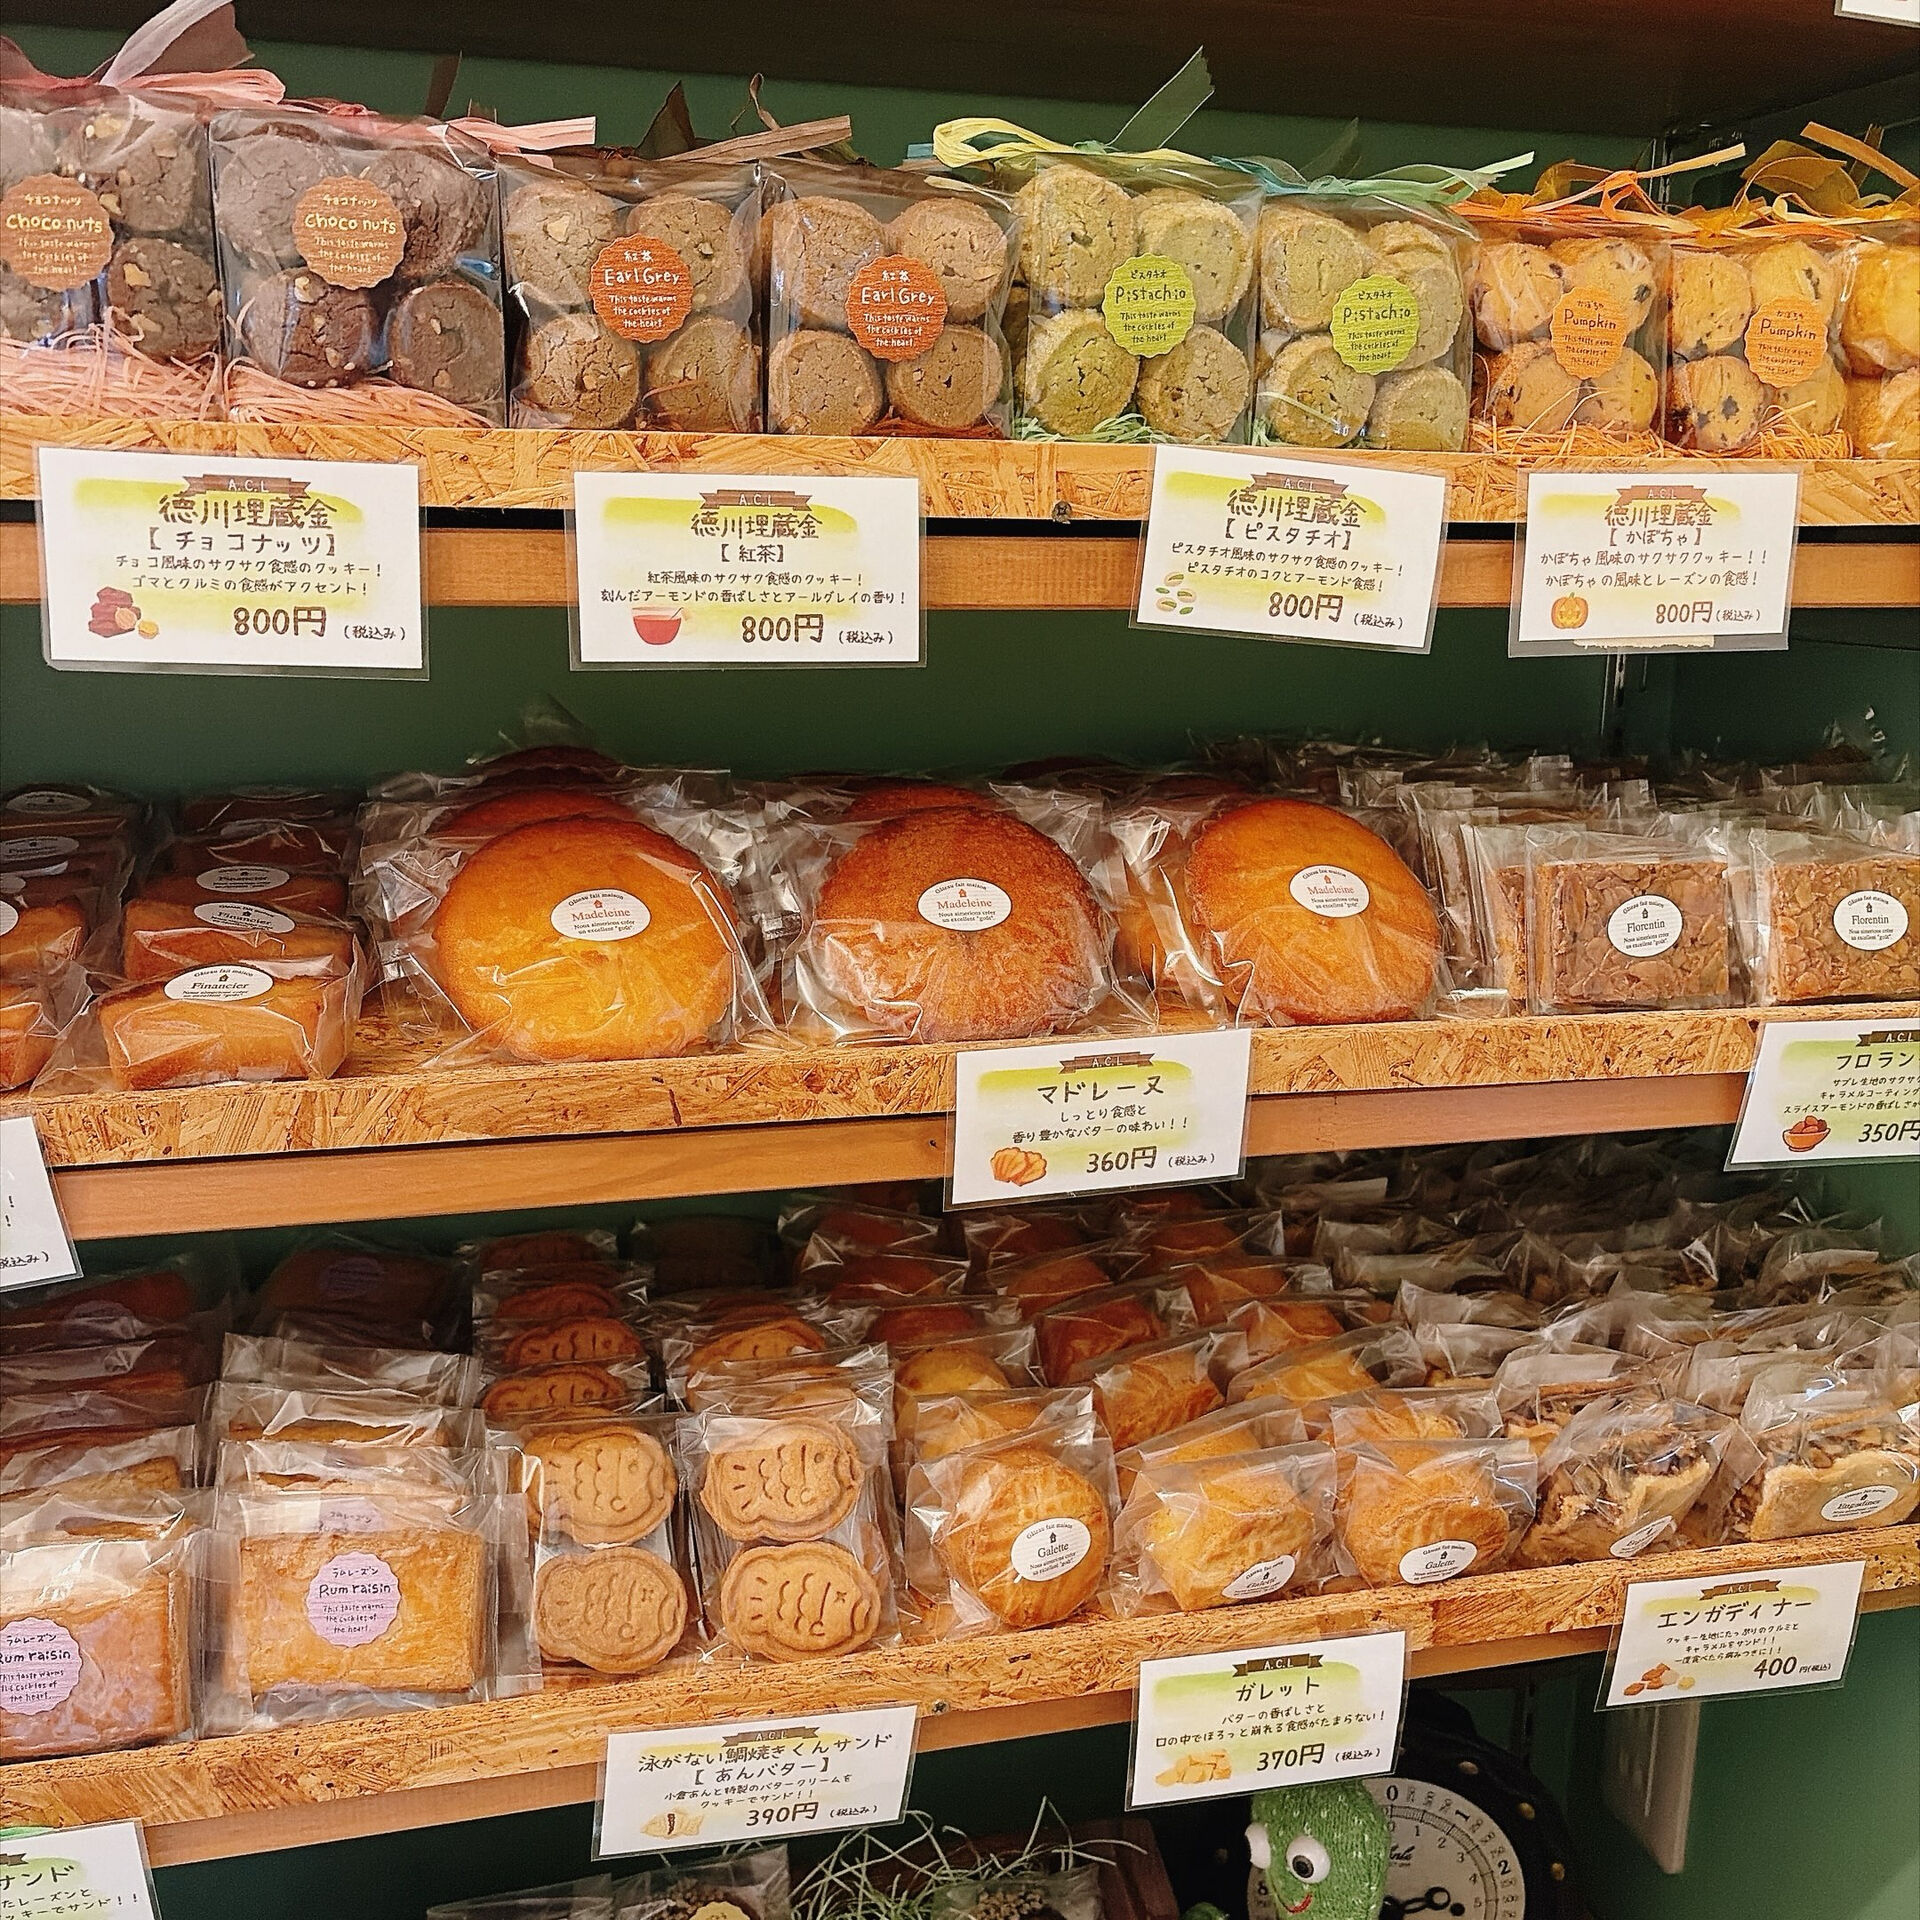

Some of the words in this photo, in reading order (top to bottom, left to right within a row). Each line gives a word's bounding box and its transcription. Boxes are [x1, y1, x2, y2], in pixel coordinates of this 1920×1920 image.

[6, 213, 61, 230] Choco
[66, 216, 103, 233] nuts
[304, 213, 358, 231] Choco
[362, 218, 396, 235] nuts
[624, 250, 654, 262] 紅茶
[604, 267, 639, 286] Earl
[643, 267, 680, 285] Grey
[881, 270, 911, 282] 紅茶
[608, 295, 627, 304] This
[629, 295, 651, 304] taste
[861, 286, 895, 305] Earl
[898, 287, 935, 306] Grey
[1115, 283, 1187, 304] Pistachio
[613, 306, 627, 315] the
[863, 313, 882, 322] This
[883, 314, 903, 323] taste
[1343, 303, 1411, 324] Pistachio
[623, 318, 637, 328] the
[1564, 308, 1617, 331] Pumpkin
[866, 325, 880, 334] the
[1760, 317, 1817, 341] Pumpkin
[875, 338, 889, 347] the
[227, 478, 271, 494] A.C.L
[738, 493, 777, 507] A.C.L
[157, 494, 339, 530] 徳川埋蔵金
[1227, 488, 1367, 529] 徳川埋蔵金
[1604, 503, 1718, 528] 徳川埋蔵金
[690, 511, 824, 540] 徳川埋蔵金
[1267, 592, 1344, 623] 800円
[1655, 601, 1713, 625] 800円
[233, 605, 327, 638] 800円
[741, 613, 824, 643] 800円
[1307, 885, 1355, 895] Madeleine
[937, 899, 992, 910] Madeleine
[571, 909, 631, 921] Madeleine
[1852, 915, 1889, 925] Florentin
[1627, 919, 1665, 933] Florentin
[191, 982, 250, 990] Financier
[1885, 1032, 1914, 1043] A.C.L
[1092, 1055, 1123, 1068] A.C.L
[1836, 1051, 1920, 1071] フロラン
[1060, 1104, 1147, 1124] しっとり食感と
[1858, 1119, 1920, 1143] 350円
[1086, 1145, 1158, 1174] 360円
[1038, 1543, 1069, 1558] Galette
[332, 1566, 379, 1578] ラムレーズン
[1425, 1560, 1455, 1569] Galette
[319, 1584, 349, 1598] Rum
[352, 1583, 391, 1595] raisin
[323, 1604, 340, 1613] This
[341, 1604, 360, 1613] taste
[1657, 1598, 1812, 1629] エンガディナー
[326, 1615, 338, 1623] the
[334, 1626, 346, 1634] the
[7, 1633, 57, 1646] ラムレーズン
[29, 1650, 71, 1661] raisin
[1262, 1658, 1294, 1670] A.C.L
[1754, 1656, 1797, 1679] 400
[0, 1673, 14, 1682] This
[17, 1672, 37, 1680] taste
[1, 1684, 13, 1692] the
[1235, 1675, 1320, 1702] ガレット
[1221, 1703, 1326, 1725] バターの香ばしさと
[638, 1733, 893, 1773] 泳がない鯛焼きくんサンド
[1256, 1743, 1326, 1772] 370円
[664, 1773, 853, 1801] 小倉あんと特製のバタークリームを
[1386, 1784, 1399, 1801] 0
[746, 1801, 819, 1827] 390円
[1497, 1860, 1512, 1876] 2
[0, 1893, 137, 1920] ッキーでサンド！！
